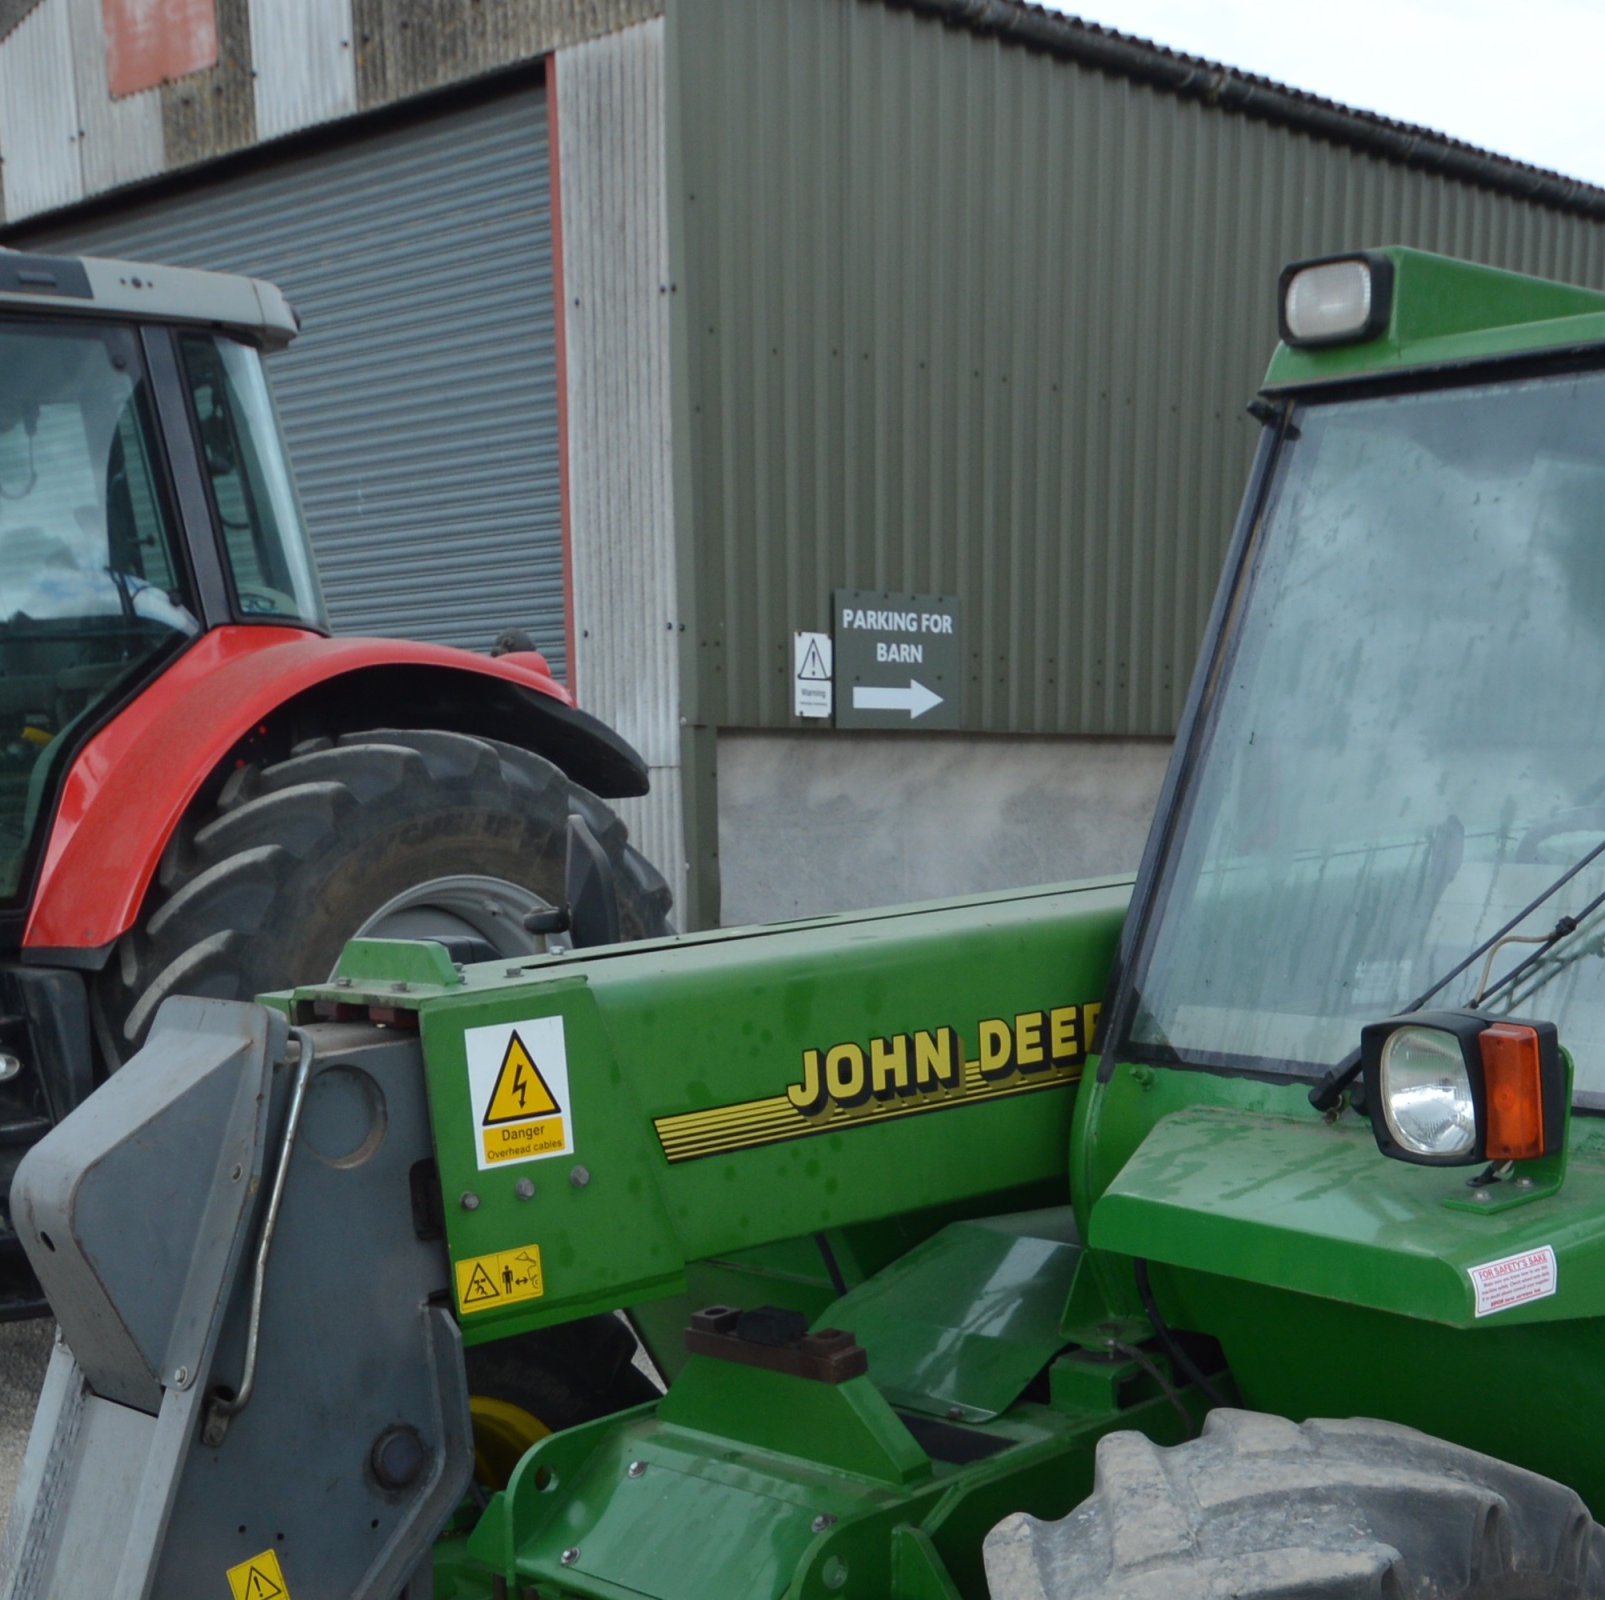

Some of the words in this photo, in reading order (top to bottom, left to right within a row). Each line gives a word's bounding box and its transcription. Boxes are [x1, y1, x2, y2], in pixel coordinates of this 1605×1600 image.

[842, 609, 918, 632] PARKING
[921, 612, 953, 634] FOR
[876, 642, 923, 663] BARN
[786, 1025, 958, 1110] JOHN
[501, 1125, 545, 1142] Danger
[487, 1145, 531, 1160] Overhead
[533, 1138, 563, 1152] cables
[1479, 1270, 1494, 1279] FOR
[1494, 1259, 1528, 1276] SAFETY'S
[1528, 1253, 1547, 1265] SAKE
